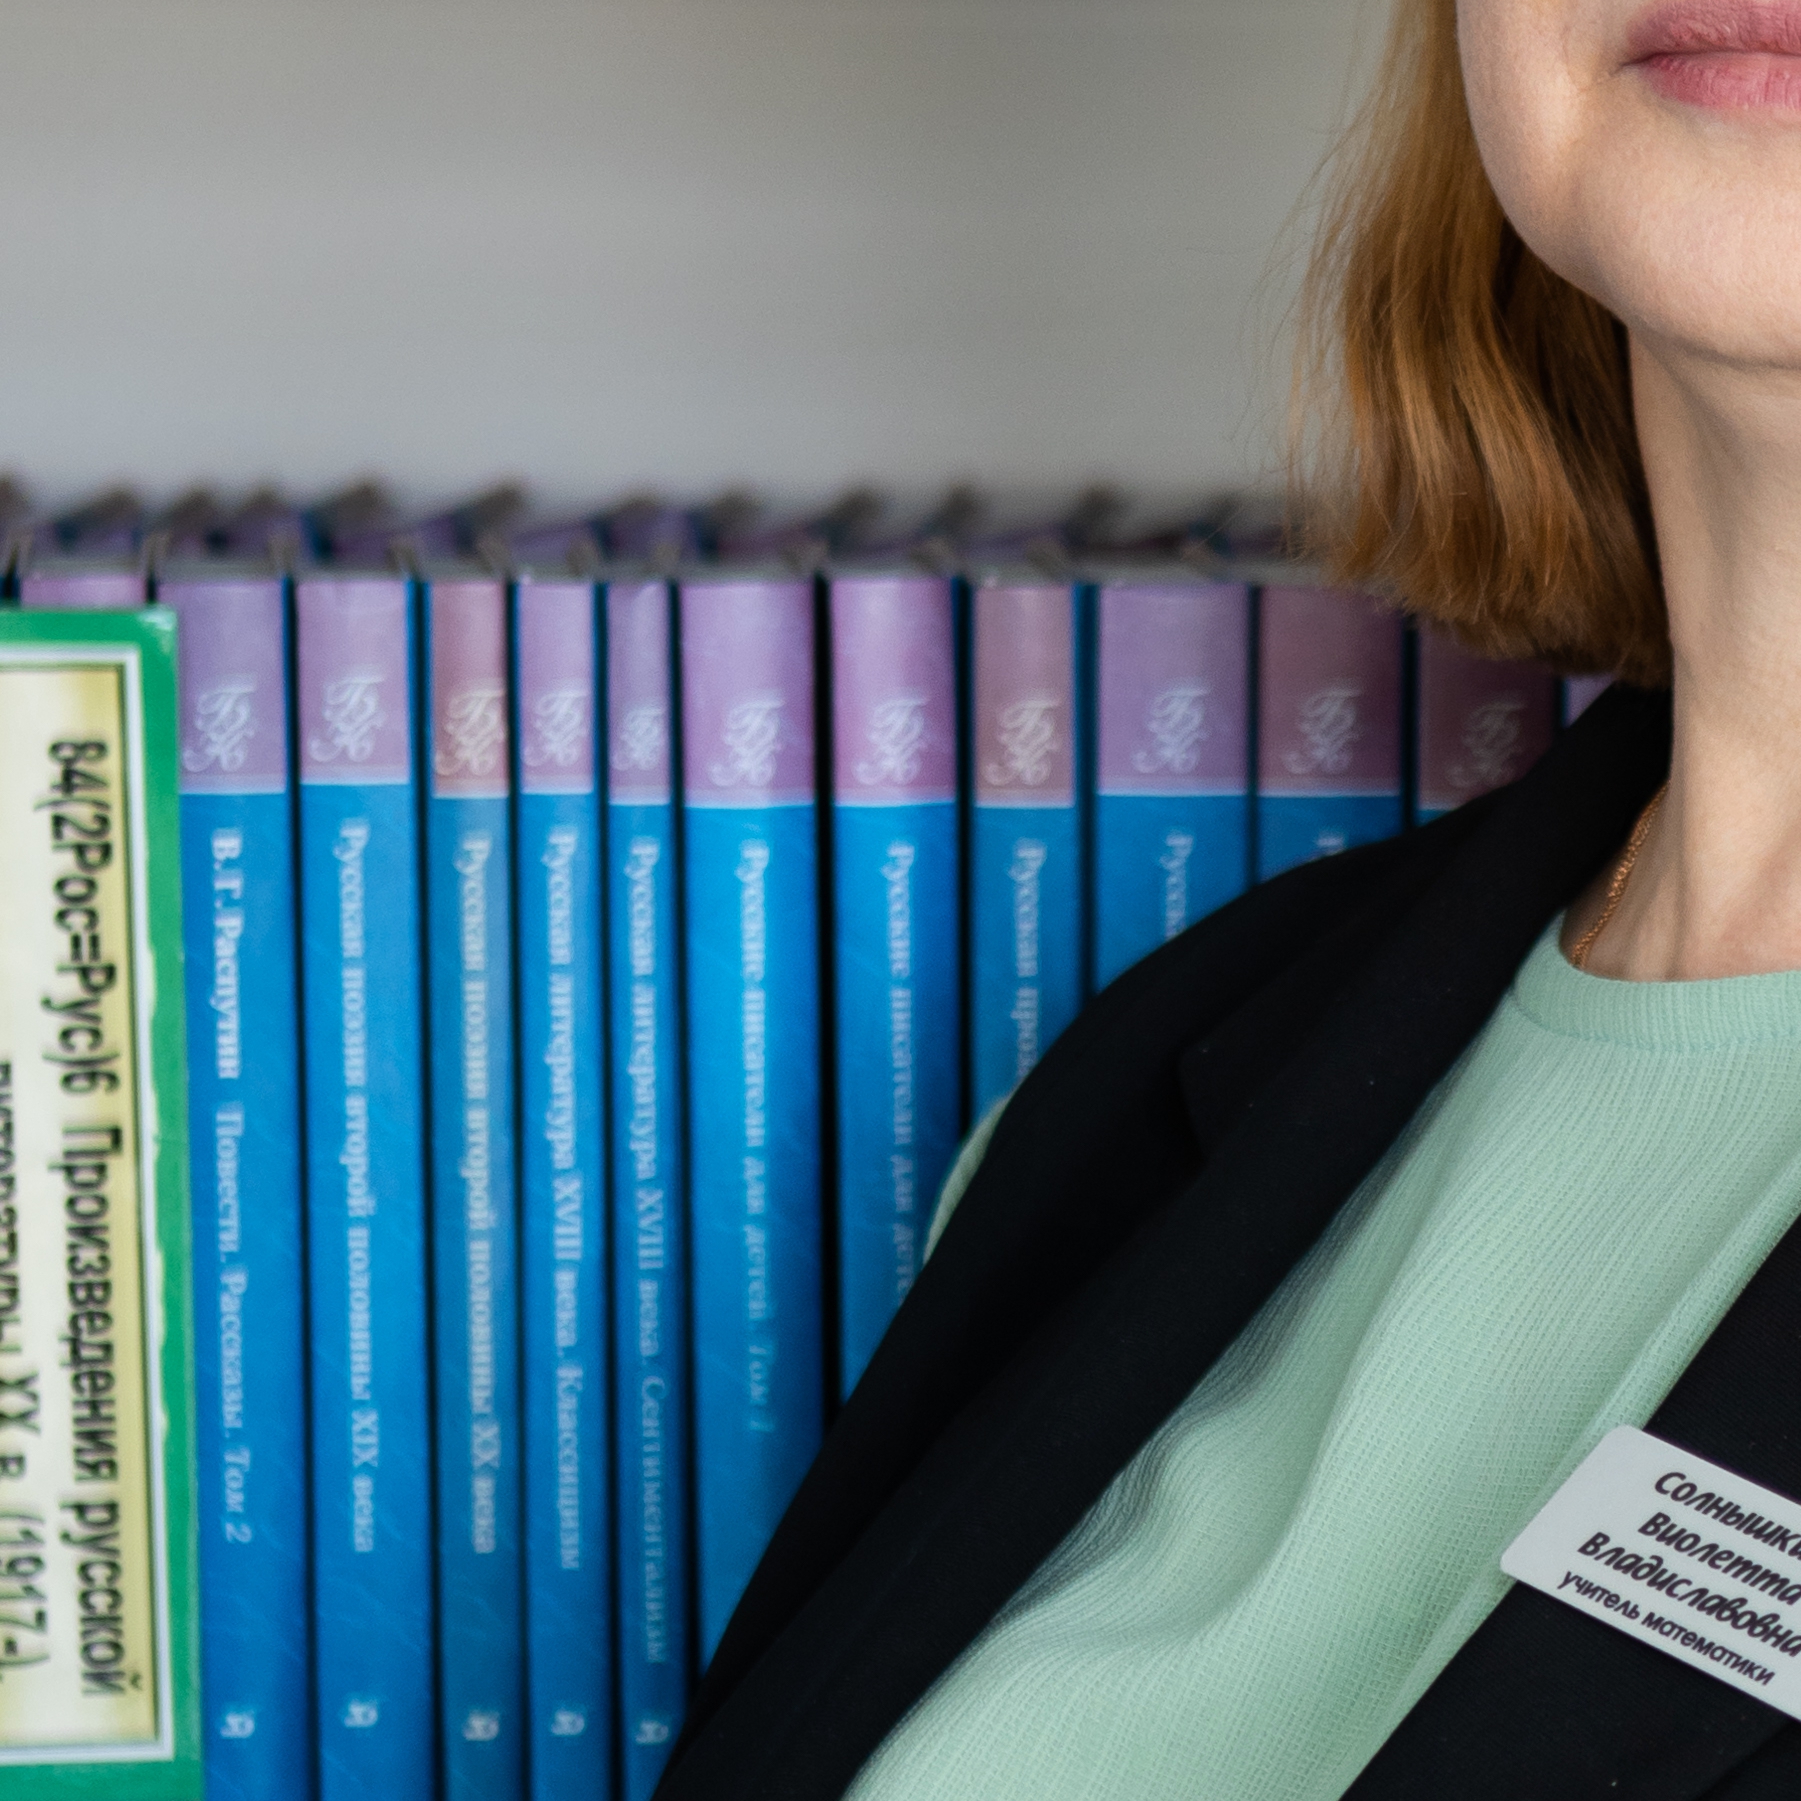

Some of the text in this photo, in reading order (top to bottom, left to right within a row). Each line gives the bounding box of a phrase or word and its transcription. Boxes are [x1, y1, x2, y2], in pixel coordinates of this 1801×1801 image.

[455, 831, 494, 970] Русская
[541, 826, 579, 964] Русская
[623, 836, 660, 975] Русская
[463, 980, 492, 1100] поэзия
[545, 973, 581, 1169] литература
[629, 984, 663, 1179] литература
[210, 828, 251, 1544] В. Г. Распутин Повести. Рассказы. Том 2
[333, 819, 380, 1553] Русская поэзия второй половины XIX века
[459, 1108, 497, 1230] второй
[553, 1176, 585, 1261] XVIII
[636, 1187, 666, 1269] XVIII
[47, 1125, 126, 1482] Произведения
[468, 1239, 499, 1415] половины
[472, 1476, 499, 1553] века
[554, 1365, 587, 1570] Классицизм
[637, 1376, 669, 1663] Сентиментализм
[61, 1500, 141, 1697] русской
[1557, 1570, 1775, 1687] учитель математики
